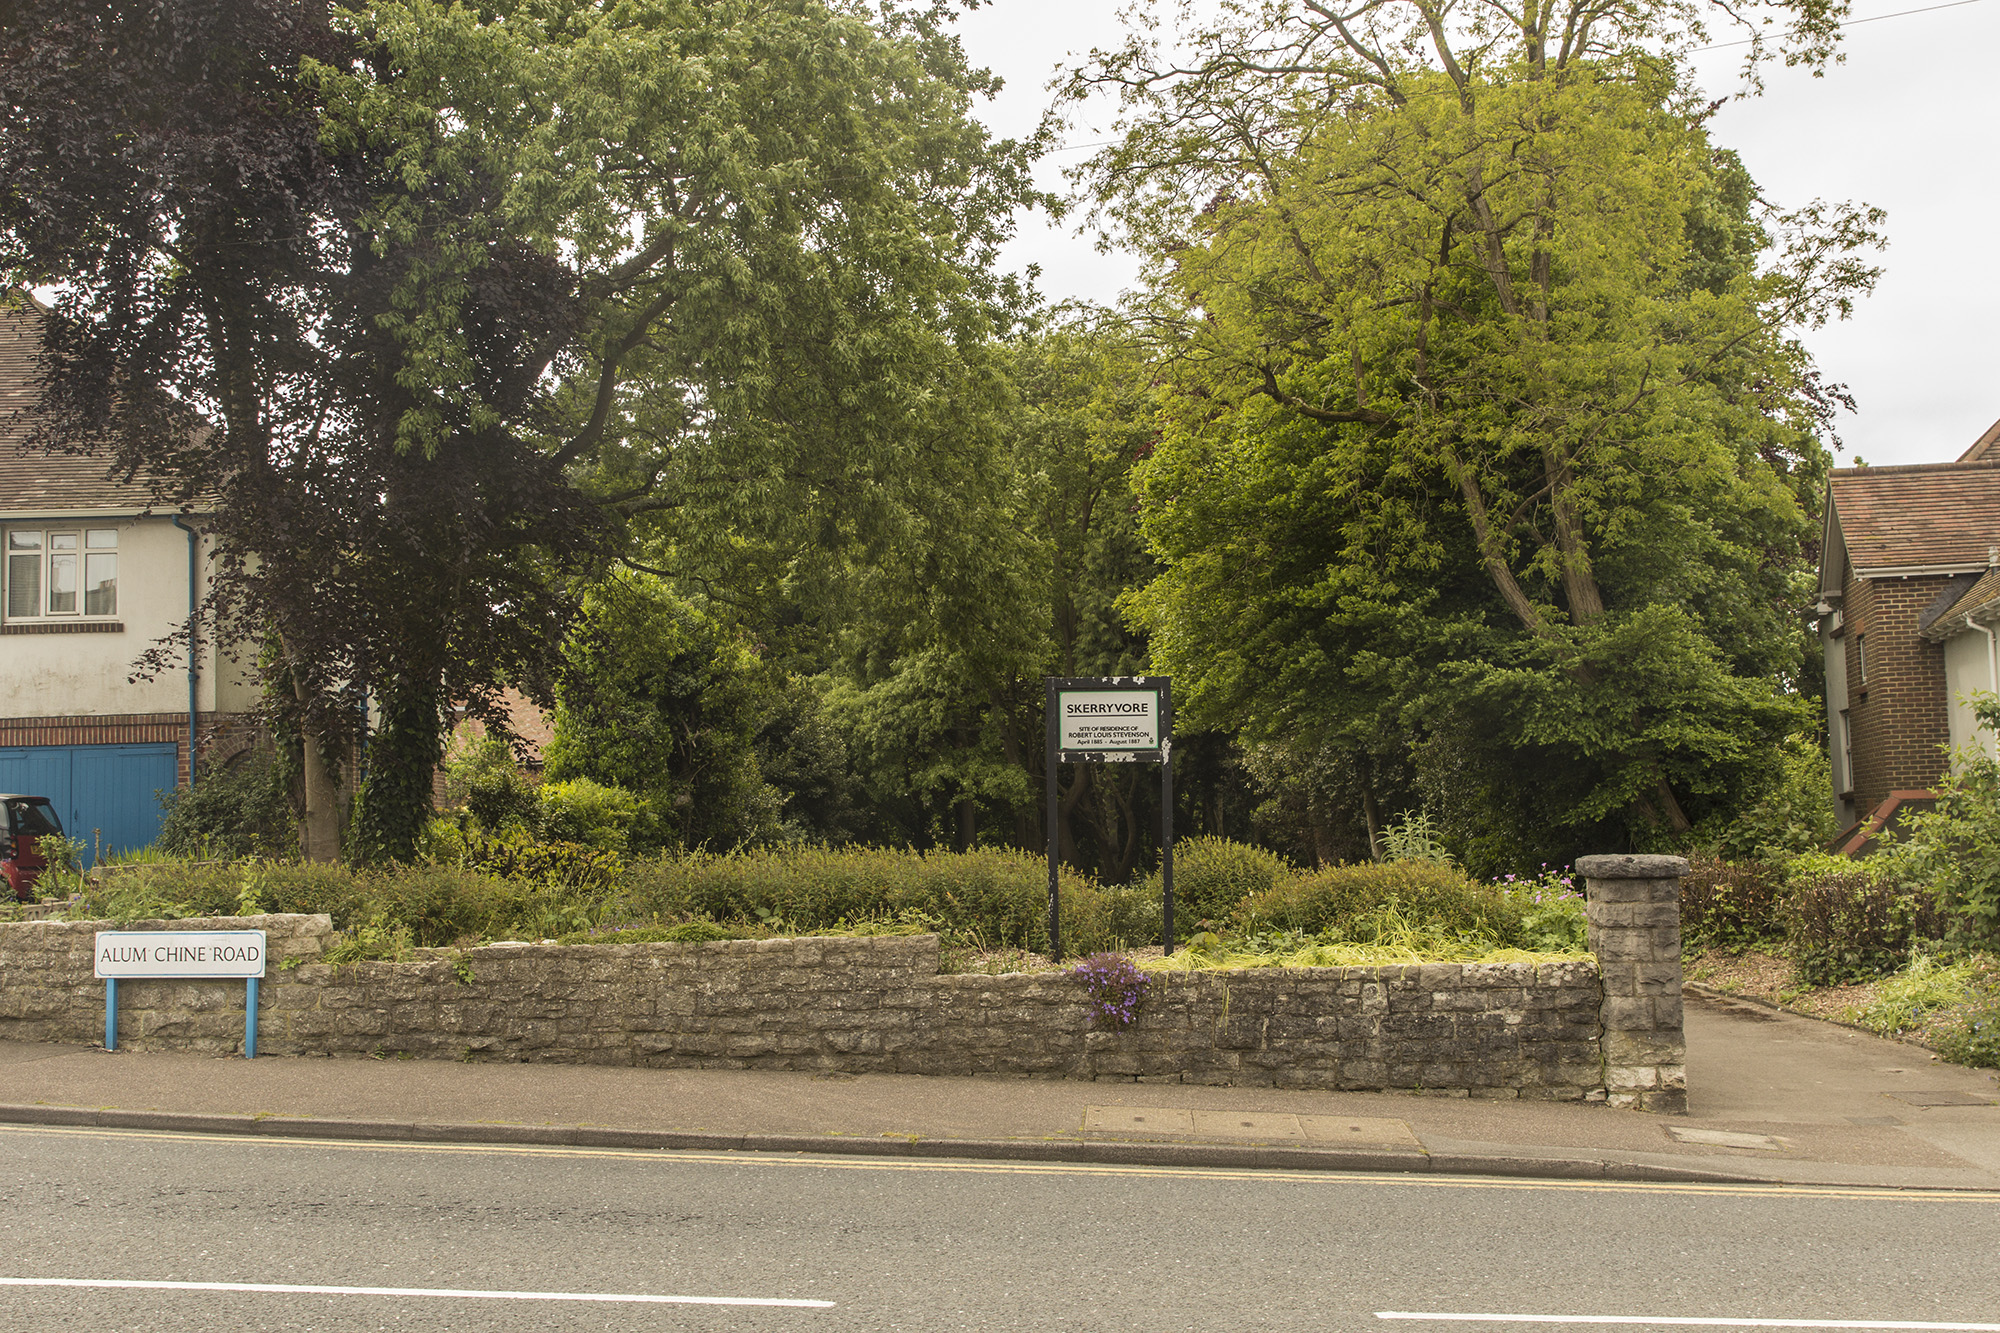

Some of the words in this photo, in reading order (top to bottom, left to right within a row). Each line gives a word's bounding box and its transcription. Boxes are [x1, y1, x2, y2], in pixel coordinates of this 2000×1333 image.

[1066, 703, 1148, 714] SKERRYVORE
[100, 947, 147, 962] ALUM
[154, 947, 206, 962] CHINE
[213, 946, 259, 961] ROAD
